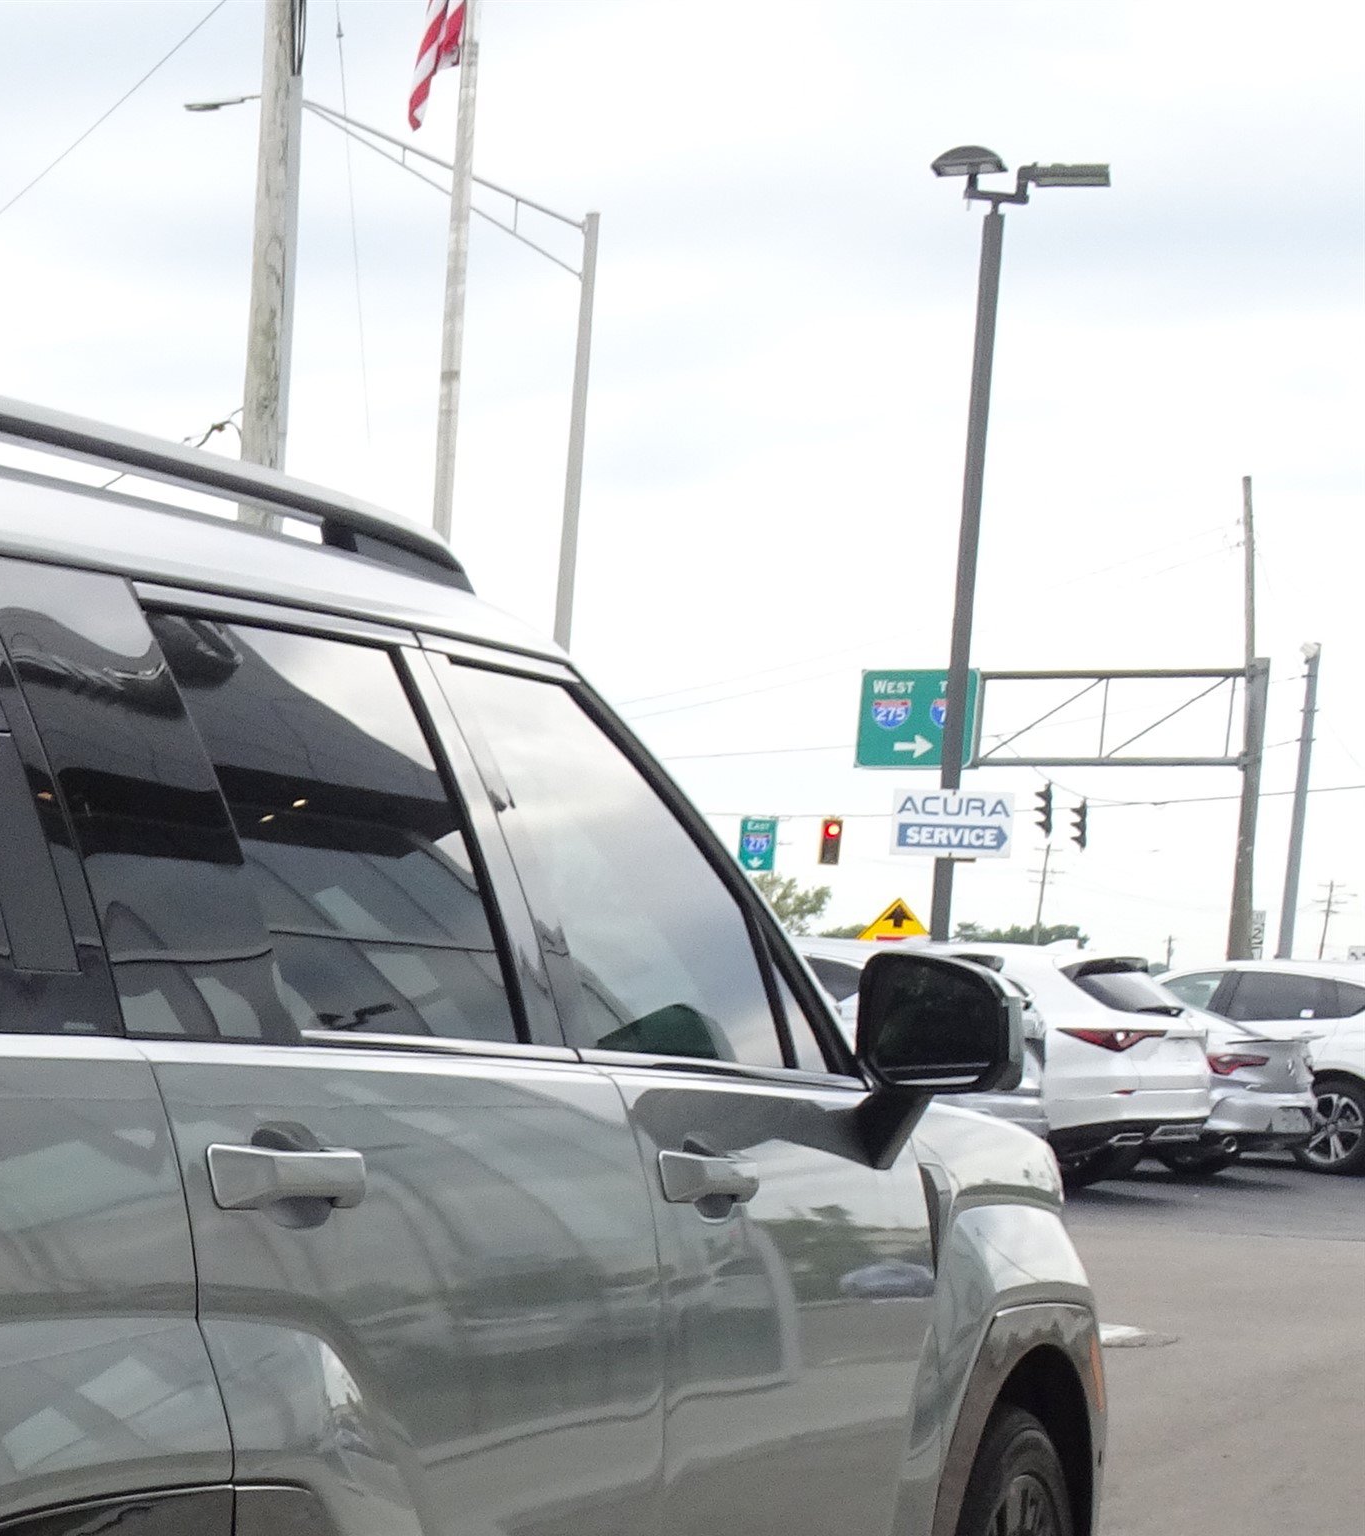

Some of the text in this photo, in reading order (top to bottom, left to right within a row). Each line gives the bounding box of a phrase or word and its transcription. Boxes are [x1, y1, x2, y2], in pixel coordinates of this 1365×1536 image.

[872, 680, 915, 694] WEST
[876, 707, 907, 721] 275
[898, 796, 1010, 818] ACURA
[906, 826, 999, 846] SERVICE
